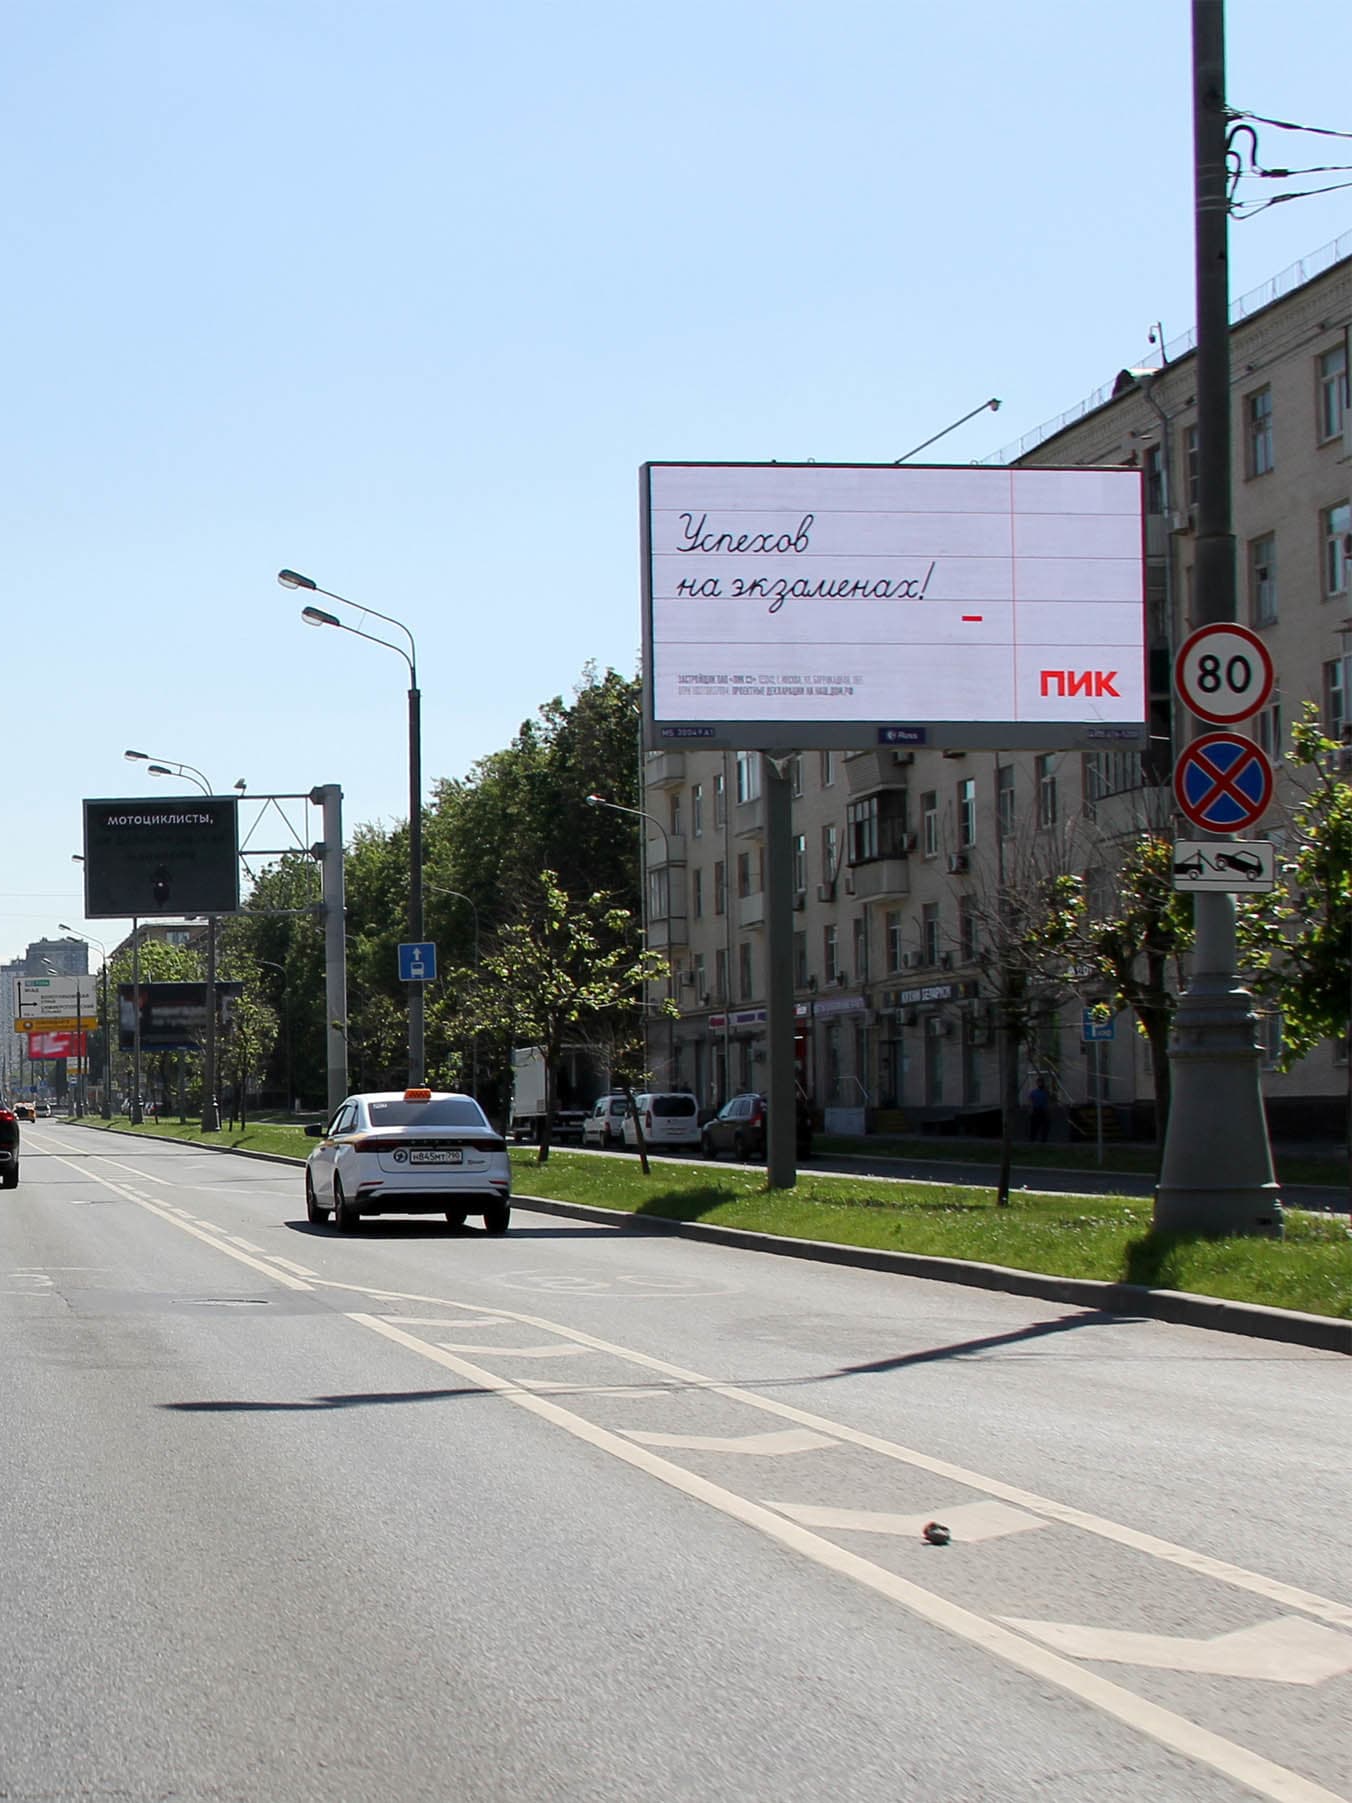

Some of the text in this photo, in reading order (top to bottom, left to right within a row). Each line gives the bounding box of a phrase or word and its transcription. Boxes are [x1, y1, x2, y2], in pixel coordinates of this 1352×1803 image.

[676, 513, 815, 553] Успехов
[676, 561, 936, 614] на экзаменах!
[1040, 671, 1121, 697] ПИК
[1198, 655, 1252, 694] 80
[107, 814, 214, 826] МОТОЦИКЛИСТЫ,
